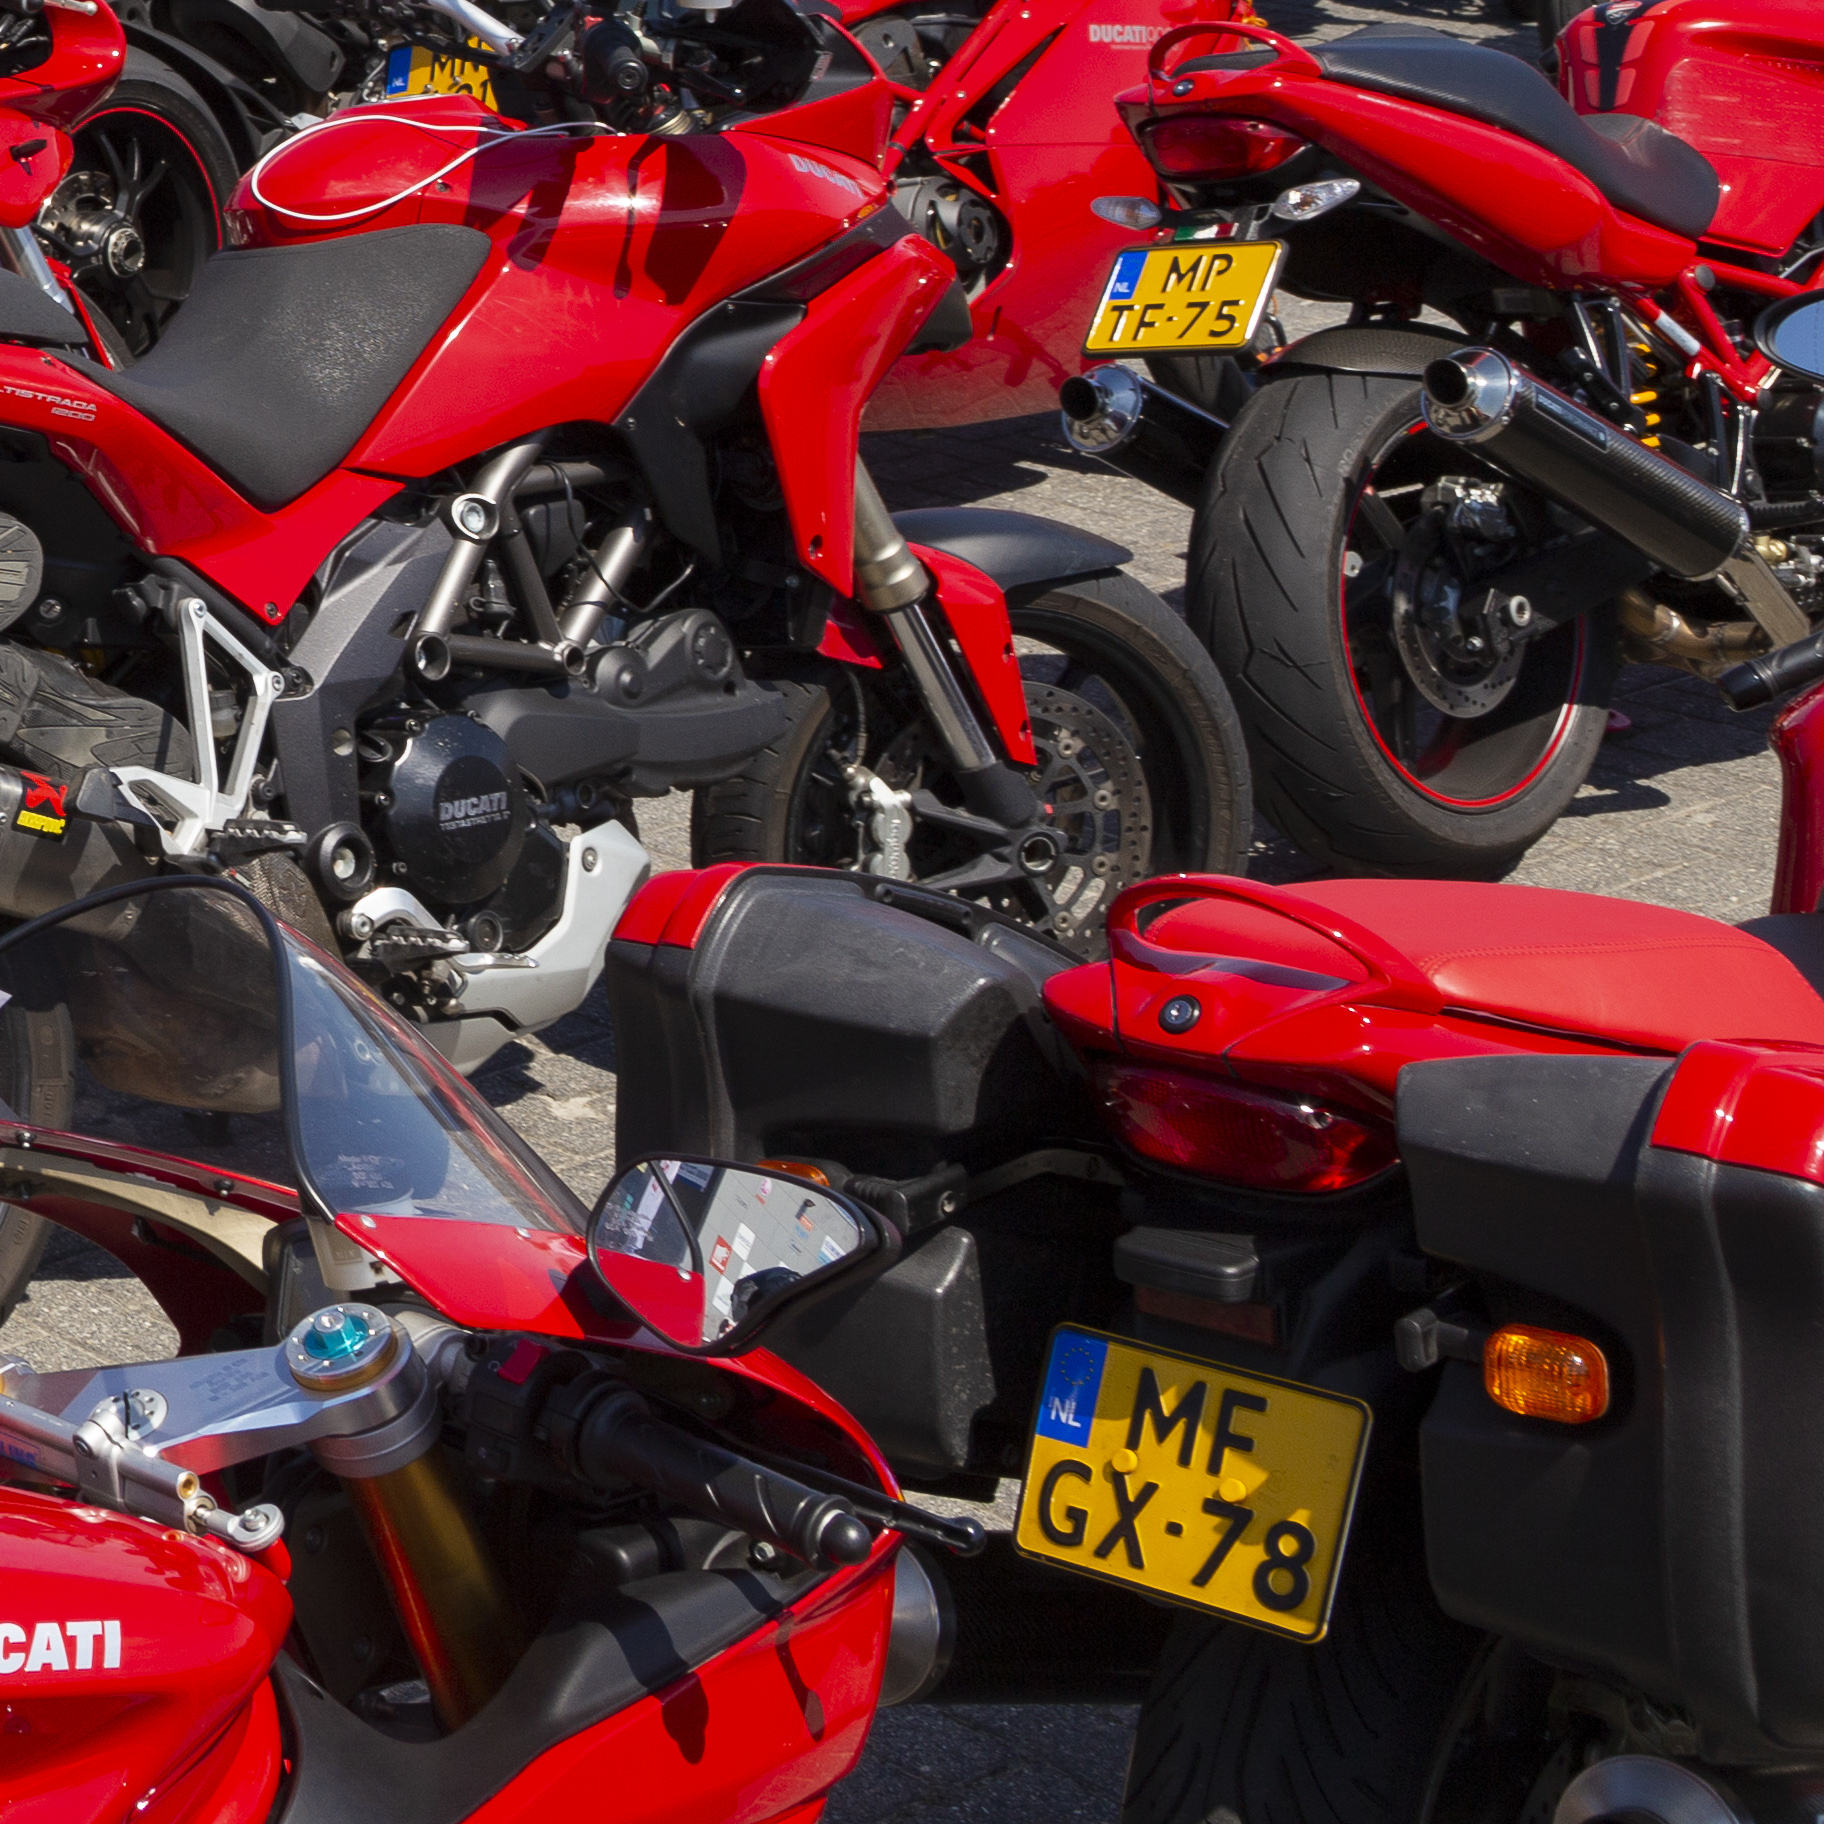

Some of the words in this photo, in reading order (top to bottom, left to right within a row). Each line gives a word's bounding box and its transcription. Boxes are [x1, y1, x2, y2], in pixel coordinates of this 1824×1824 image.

[1089, 23, 1147, 43] DUCATI
[789, 153, 866, 201] DUCATI
[1114, 281, 1131, 294] NL
[1165, 253, 1234, 295] MP
[1108, 299, 1241, 342] TF-75
[50, 406, 97, 422] 1200
[439, 791, 508, 821] DUCATI
[1049, 1396, 1082, 1429] NL
[1126, 1366, 1268, 1475] MF
[1038, 1459, 1316, 1612] GX-78
